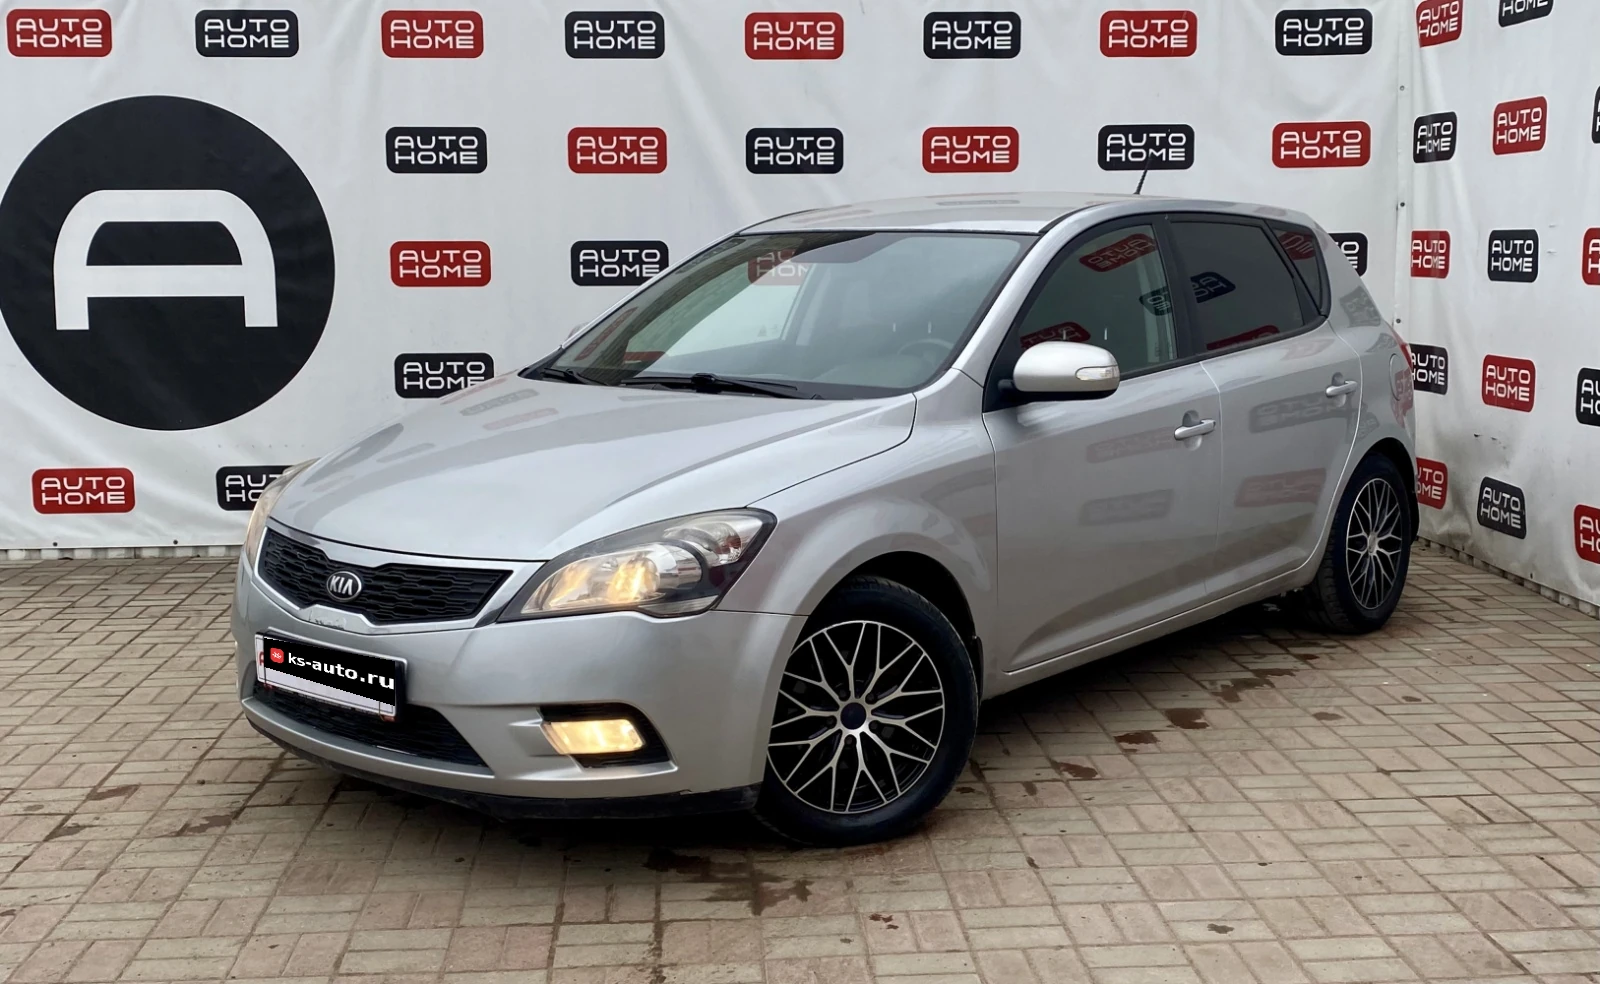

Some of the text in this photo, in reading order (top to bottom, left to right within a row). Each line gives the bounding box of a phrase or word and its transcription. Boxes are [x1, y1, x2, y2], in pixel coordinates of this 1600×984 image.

[1418, 1, 1460, 23] AUTO
[16, 19, 103, 32] AUTO
[204, 19, 290, 33] AUTO
[390, 20, 475, 33] AUTO
[573, 21, 657, 34] AUTO
[753, 22, 836, 35] AUTO
[931, 21, 1013, 34] AUTO
[1108, 20, 1190, 33] AUTO
[1283, 18, 1365, 32] AUTO
[1418, 17, 1459, 39] HOME
[16, 34, 103, 48] HOME
[204, 34, 290, 49] HOME
[390, 35, 475, 49] HOME
[573, 36, 656, 50] HOME
[753, 37, 835, 51] HOME
[931, 36, 1012, 50] HOME
[1108, 35, 1188, 49] HOME
[1282, 33, 1363, 47] HOME
[1496, 107, 1543, 128] AUTO
[1280, 130, 1363, 145] AUTO
[1417, 122, 1454, 139] AUTO
[1496, 125, 1541, 145] HOME
[395, 136, 479, 149] AUTO
[576, 136, 659, 150] AUTO
[754, 136, 836, 150] AUTO
[930, 135, 1012, 149] AUTO
[1106, 133, 1187, 147] AUTO
[1416, 138, 1452, 154] HOME
[395, 151, 478, 165] HOME
[577, 151, 658, 165] HOME
[754, 151, 835, 165] HOME
[930, 150, 1010, 165] HOME
[1106, 148, 1186, 162] HOME
[1280, 145, 1361, 160] HOME
[1411, 240, 1447, 254] AUTO
[1491, 239, 1534, 255] AUTO
[53, 189, 278, 331] A
[399, 250, 483, 263] AUTO
[579, 250, 661, 263] AUTO
[1411, 255, 1446, 269] HOME
[399, 265, 482, 279] HOME
[579, 265, 661, 278] HOME
[1490, 257, 1533, 273] HOME
[403, 362, 486, 375] AUTO
[1486, 365, 1531, 385] AUTO
[1485, 381, 1531, 402] HOME
[41, 477, 126, 491] AUTO
[42, 492, 126, 506] HOME
[1482, 486, 1522, 512] AUTO
[1480, 502, 1523, 530] HOME
[329, 575, 353, 597] KIA
